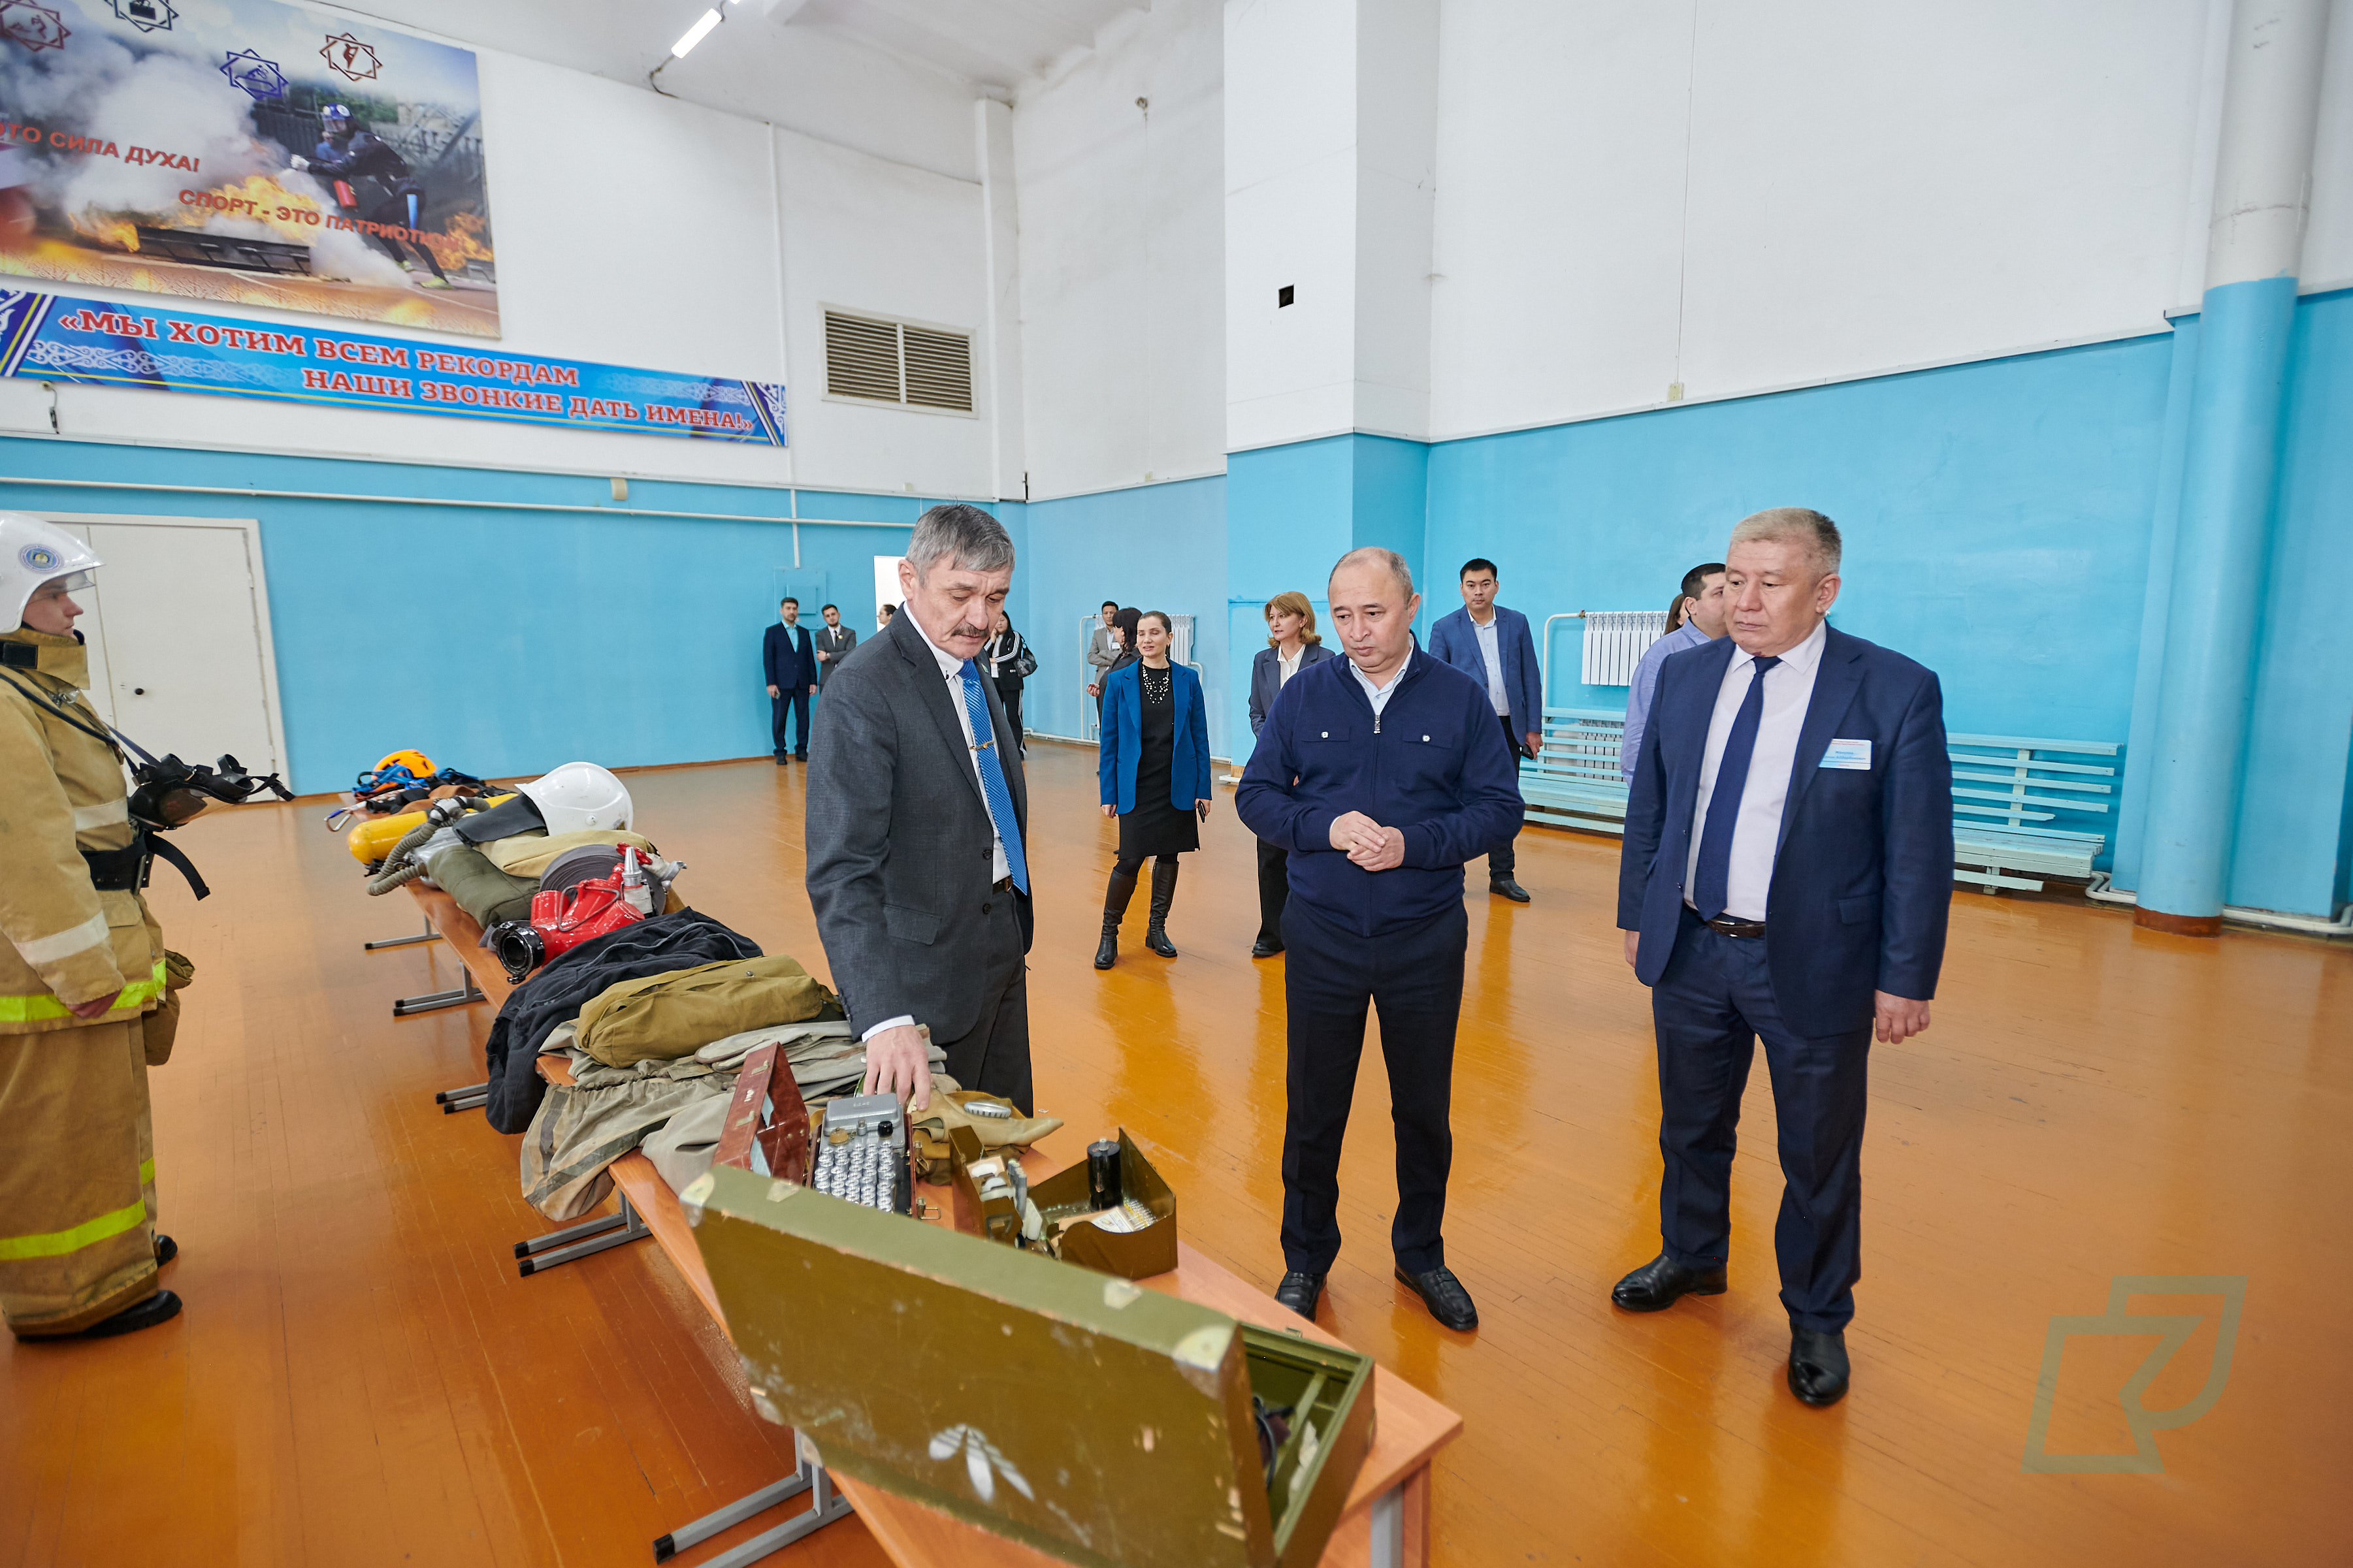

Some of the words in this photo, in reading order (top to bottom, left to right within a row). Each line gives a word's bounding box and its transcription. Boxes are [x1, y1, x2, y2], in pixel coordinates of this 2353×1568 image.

[49, 131, 120, 157] СИЛА
[125, 146, 200, 172] ДУХА!
[179, 189, 258, 215] СПОРТ
[276, 206, 320, 226] ЭТО
[59, 310, 157, 338] «МЫ
[167, 320, 306, 356] ХОТИМ
[315, 339, 408, 367] ВСЕМ
[417, 351, 579, 387] РЕКОРДАМ
[302, 369, 413, 398] НАШИ
[420, 381, 562, 413] ЗВОНКИЕ
[568, 396, 638, 419] ДАТЬ
[645, 404, 754, 432] ИМЕНА!»
